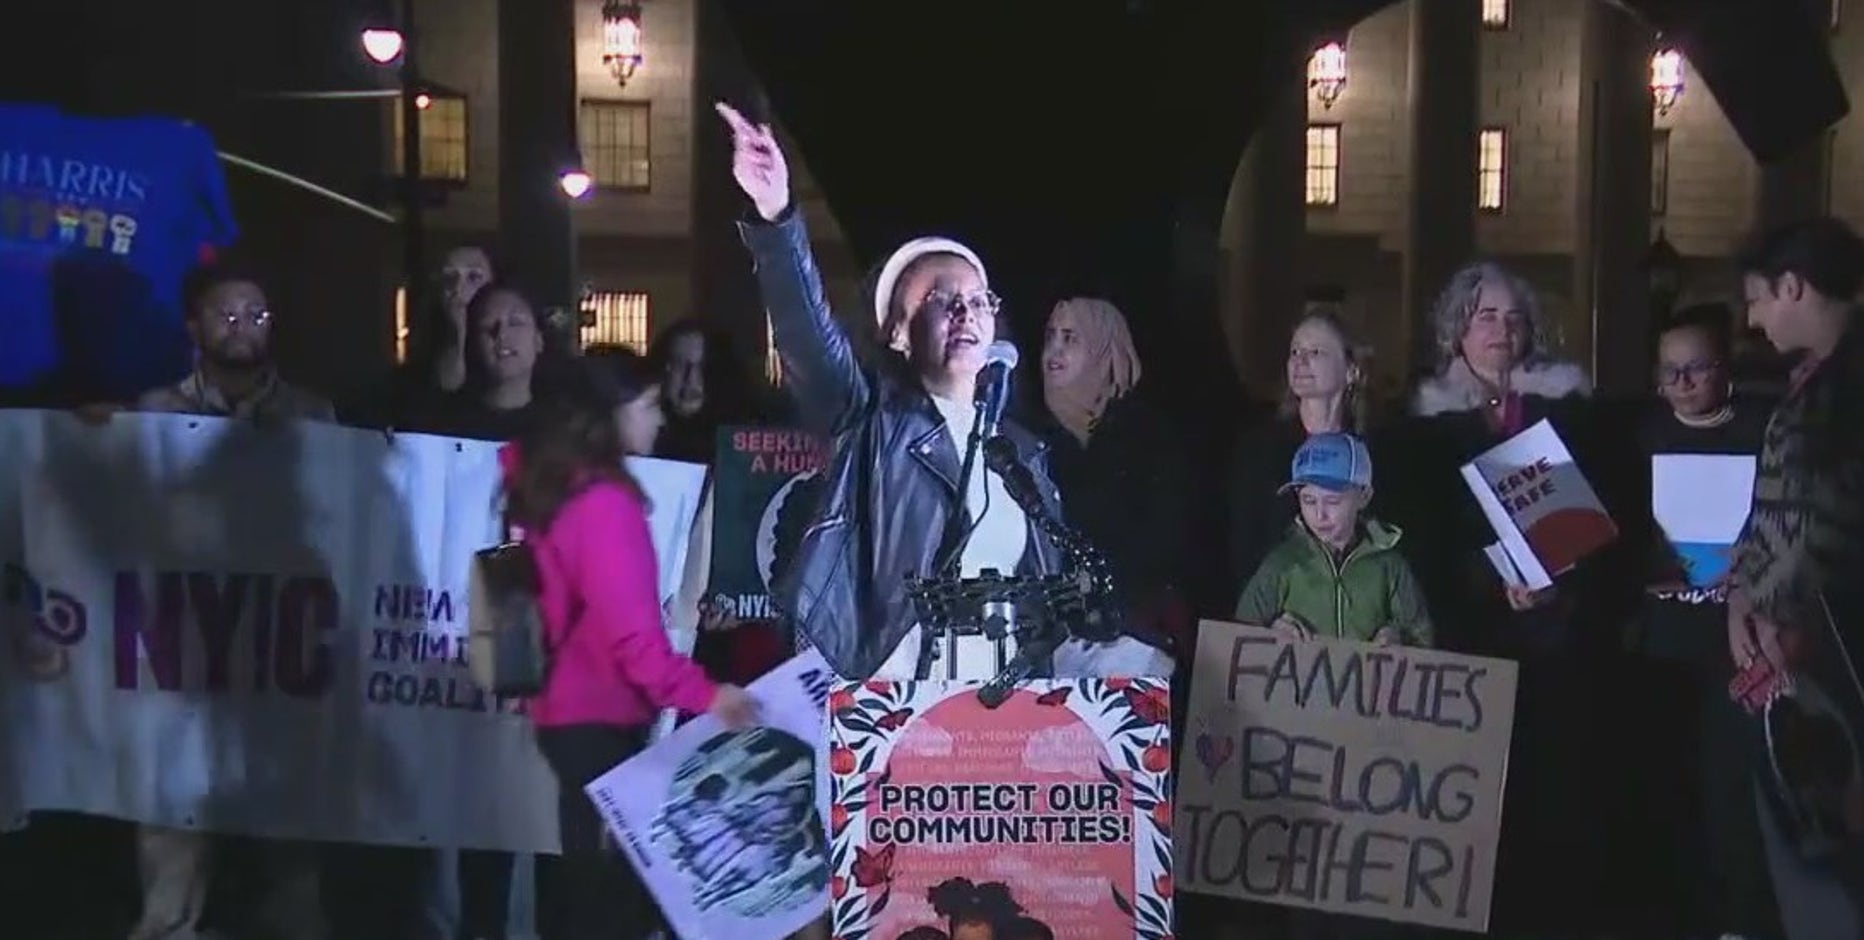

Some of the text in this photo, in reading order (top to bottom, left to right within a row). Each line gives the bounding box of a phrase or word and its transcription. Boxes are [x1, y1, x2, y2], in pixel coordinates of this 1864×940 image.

[1, 151, 147, 202] HARRIS
[733, 430, 820, 453] SEEKIN
[751, 454, 826, 475] A HUM
[113, 571, 338, 697] NYIC
[372, 628, 470, 669] IMMI
[1227, 636, 1487, 732] FAMILIES
[1241, 726, 1479, 822] BELONG
[880, 783, 1119, 812] PROTECT OUR
[868, 815, 1133, 844] COMMUNITIES!
[1181, 804, 1475, 919] TOGETHER!
